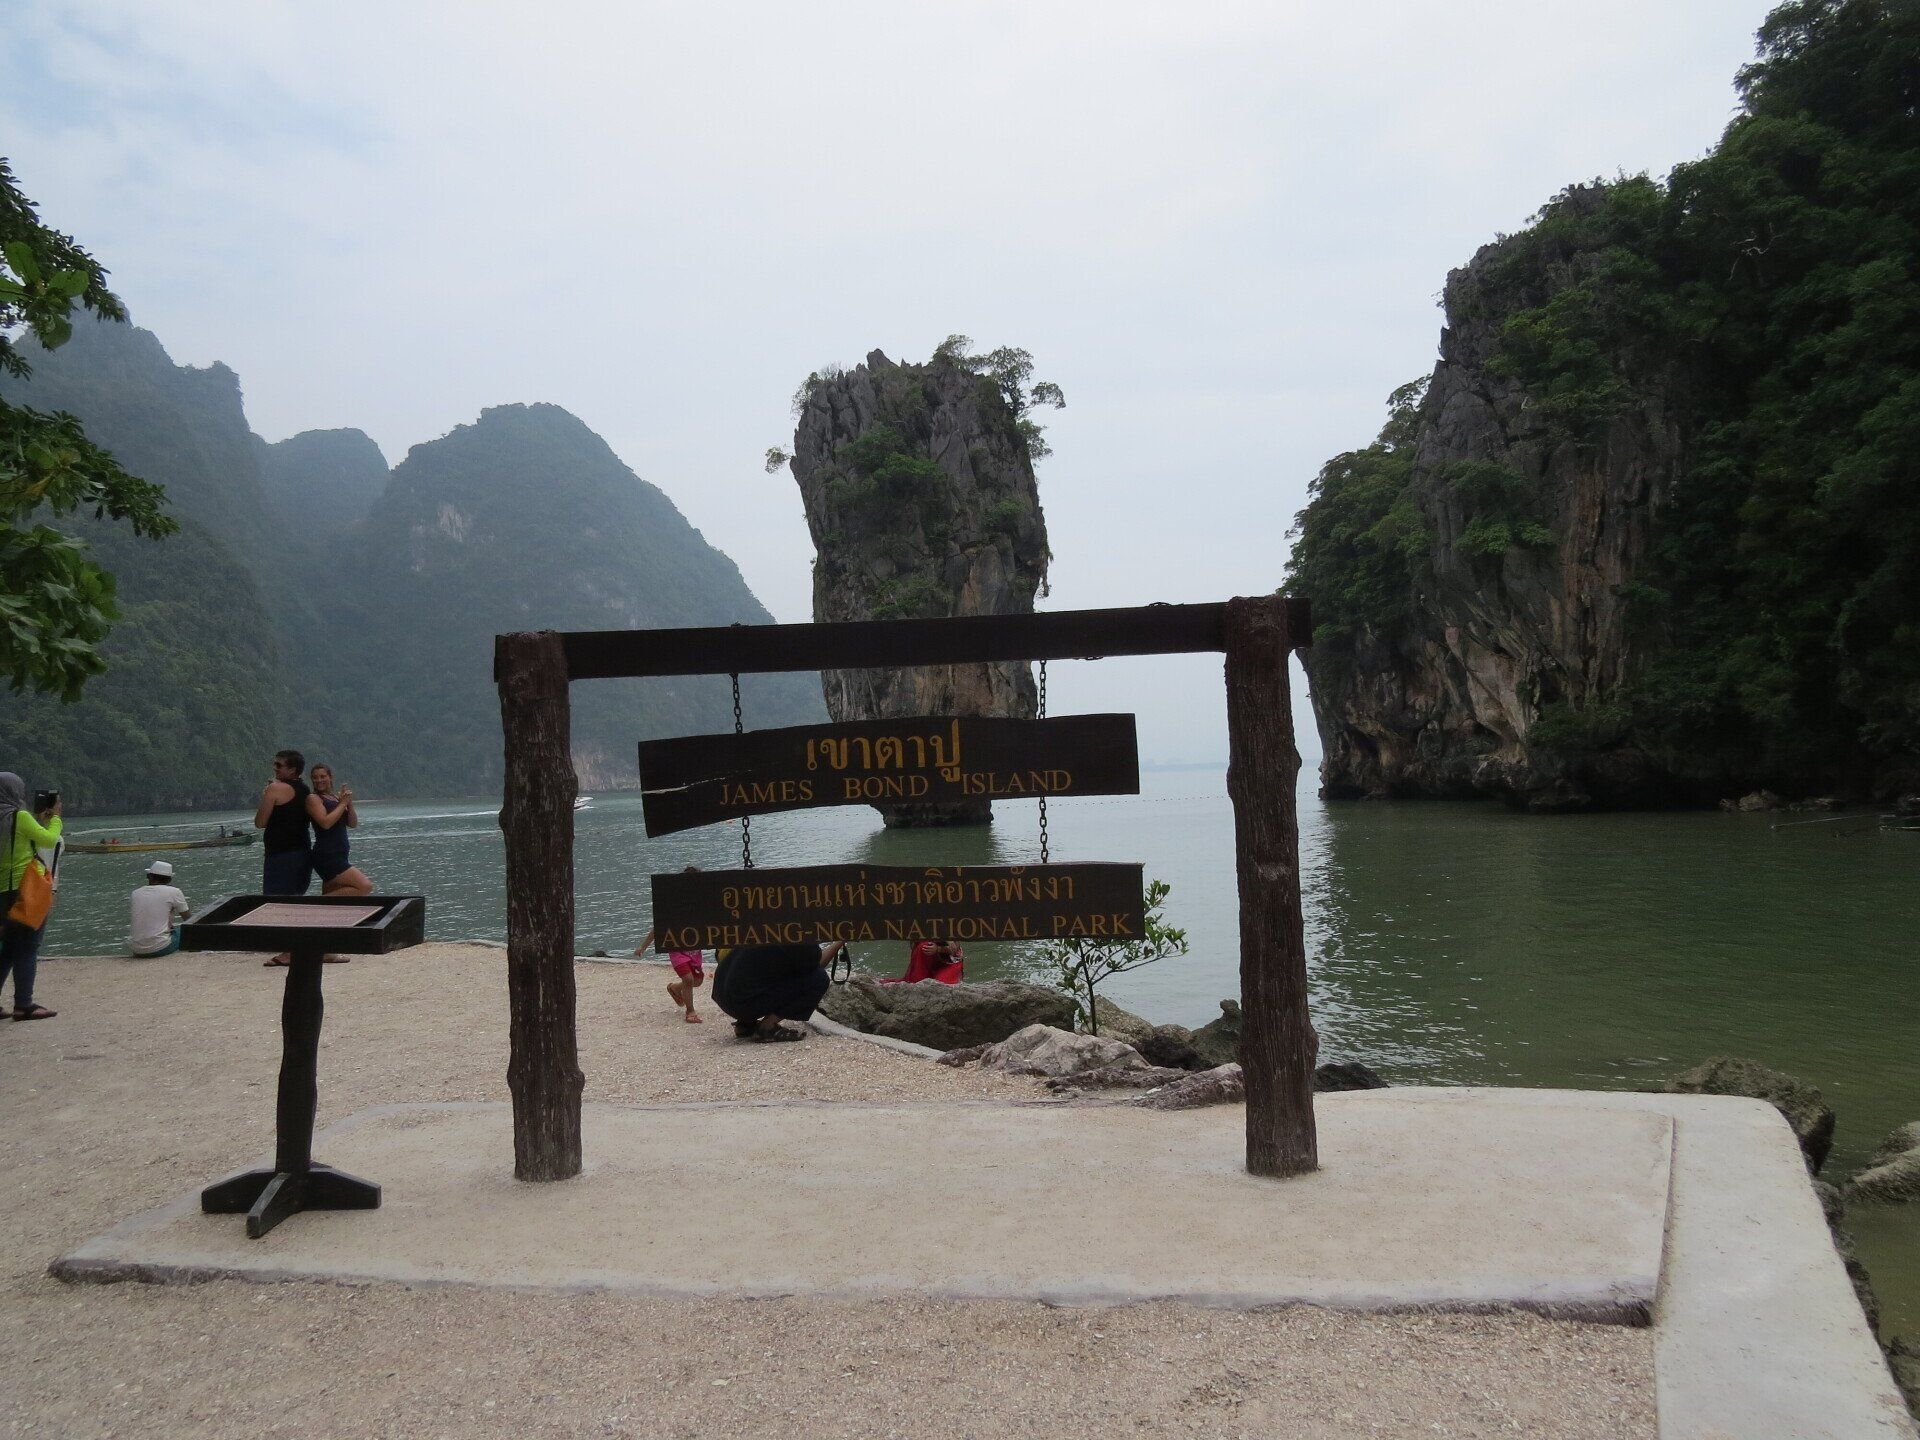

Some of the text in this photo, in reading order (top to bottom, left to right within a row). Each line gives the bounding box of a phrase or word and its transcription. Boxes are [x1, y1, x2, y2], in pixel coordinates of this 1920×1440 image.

[807, 719, 961, 782] เขาตาปู
[720, 769, 1072, 806] JAMES BOND ISLAND
[661, 913, 1134, 948] AO PHANG-NGA NATIONAL PARK
